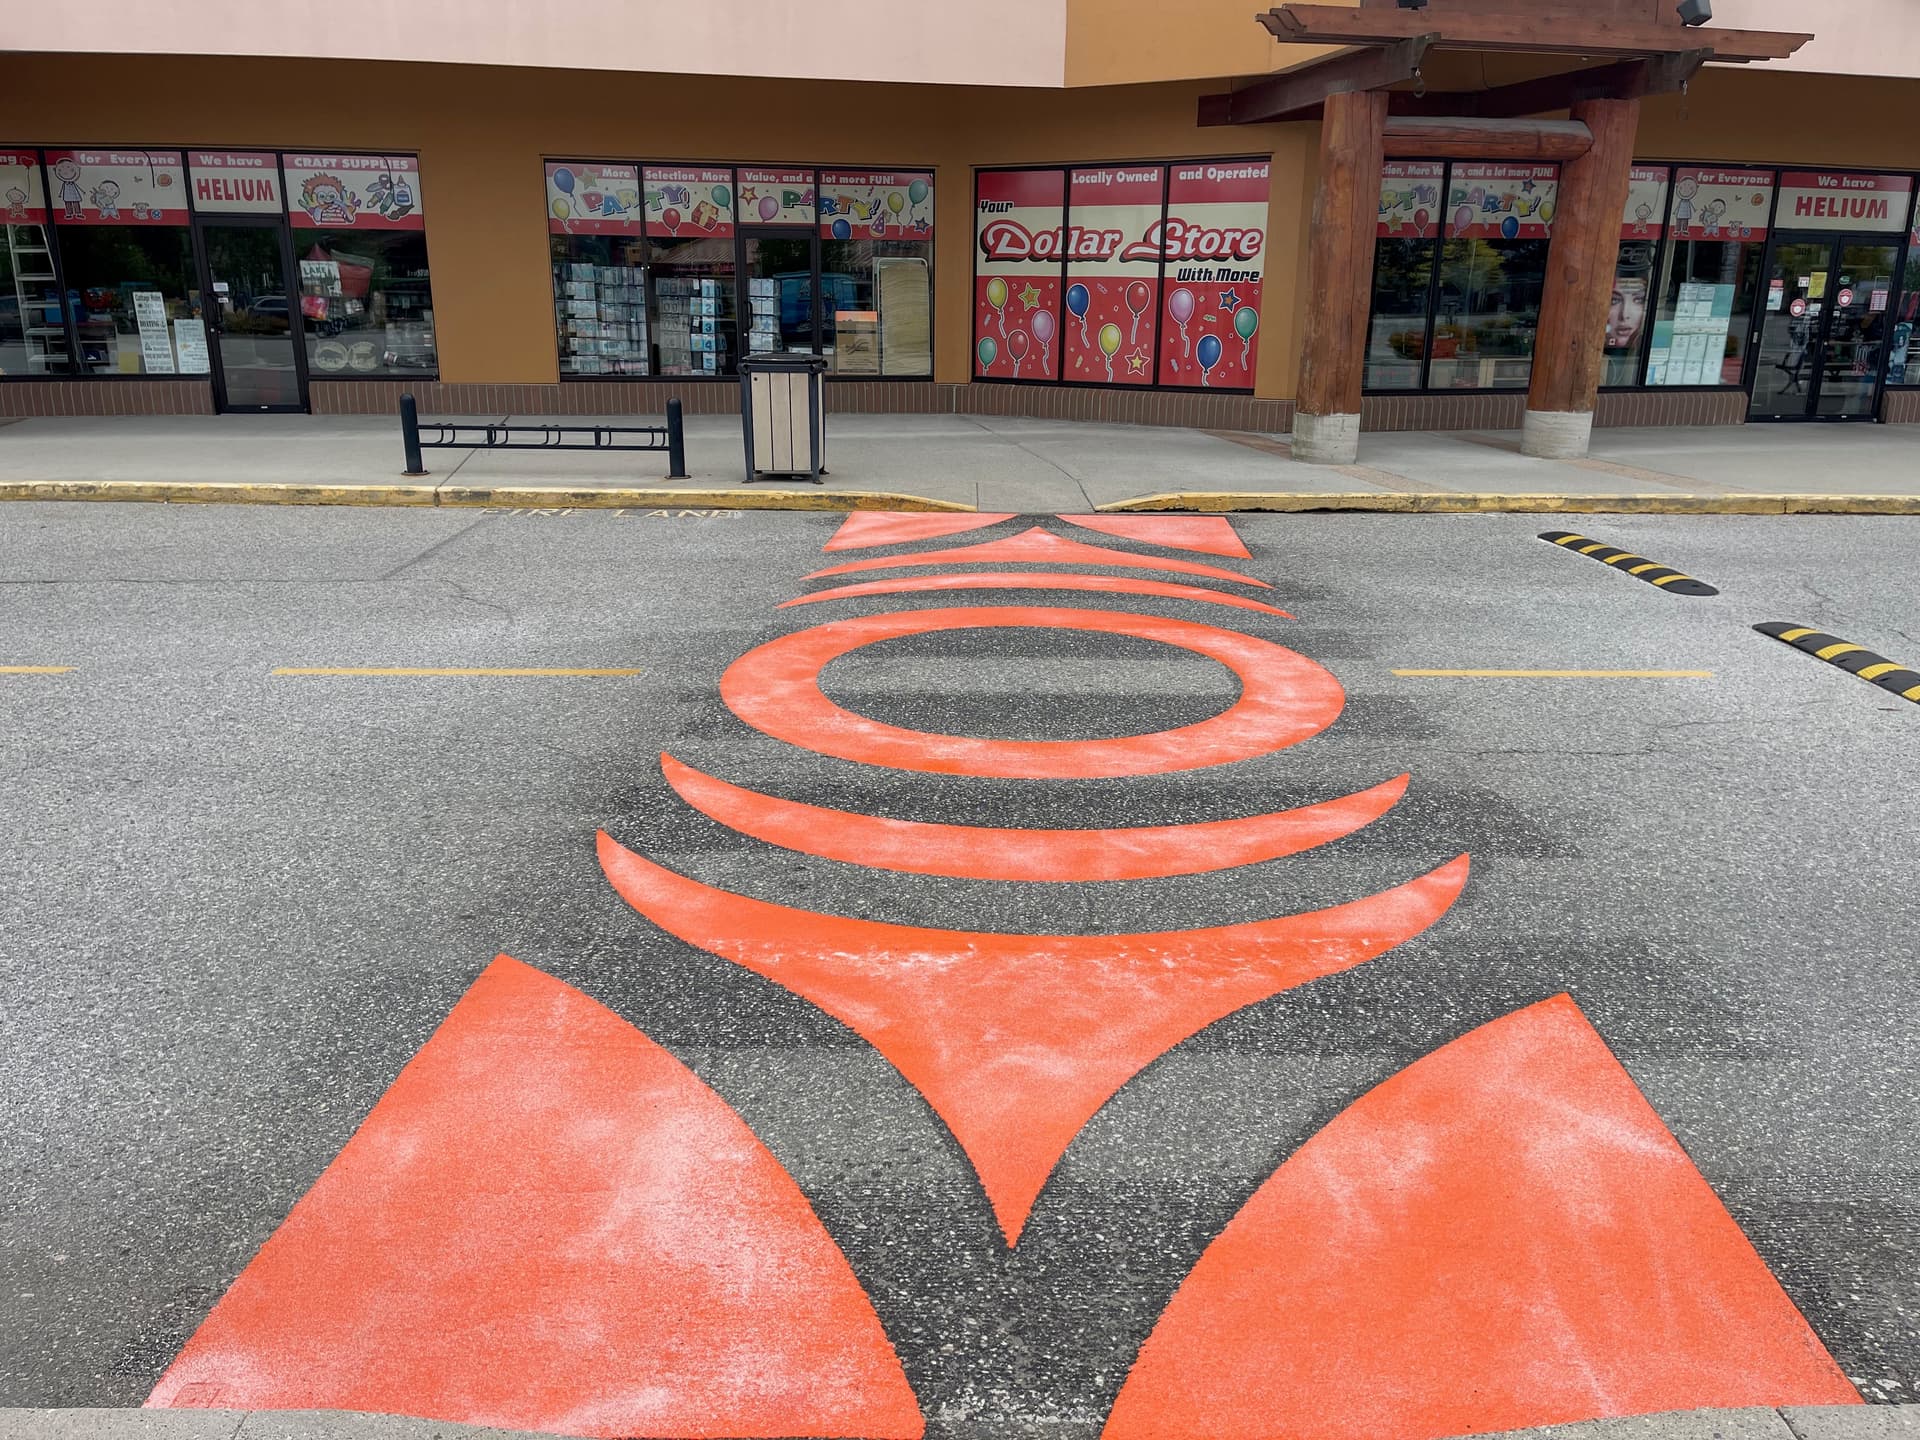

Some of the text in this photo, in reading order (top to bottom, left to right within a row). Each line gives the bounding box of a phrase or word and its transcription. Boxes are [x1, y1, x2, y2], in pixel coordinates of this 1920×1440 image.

[79, 154, 176, 167] for Everyone
[200, 155, 262, 167] We have
[294, 157, 409, 170] CRAFT SUPPLIES
[602, 167, 895, 185] More Selection, More Value, and a lot more FUN!
[1072, 165, 1269, 185] Locally Owned and Operated
[1407, 165, 1431, 176] More
[1467, 167, 1485, 177] and
[1486, 169, 1493, 177] a
[1494, 166, 1507, 177] lot
[1508, 168, 1531, 177] more
[1532, 167, 1553, 178] FUN!
[1697, 171, 1771, 186] for Everyone
[196, 178, 275, 201] HELIUM
[1818, 176, 1875, 189] We have
[580, 184, 690, 216] PARTY!
[782, 188, 881, 220] PARTY!
[980, 200, 1014, 213] Your
[1449, 186, 1542, 218] PARTY!
[1795, 195, 1888, 219] HELIUM
[980, 217, 1264, 263] Dollar Store
[1176, 268, 1260, 283] With More
